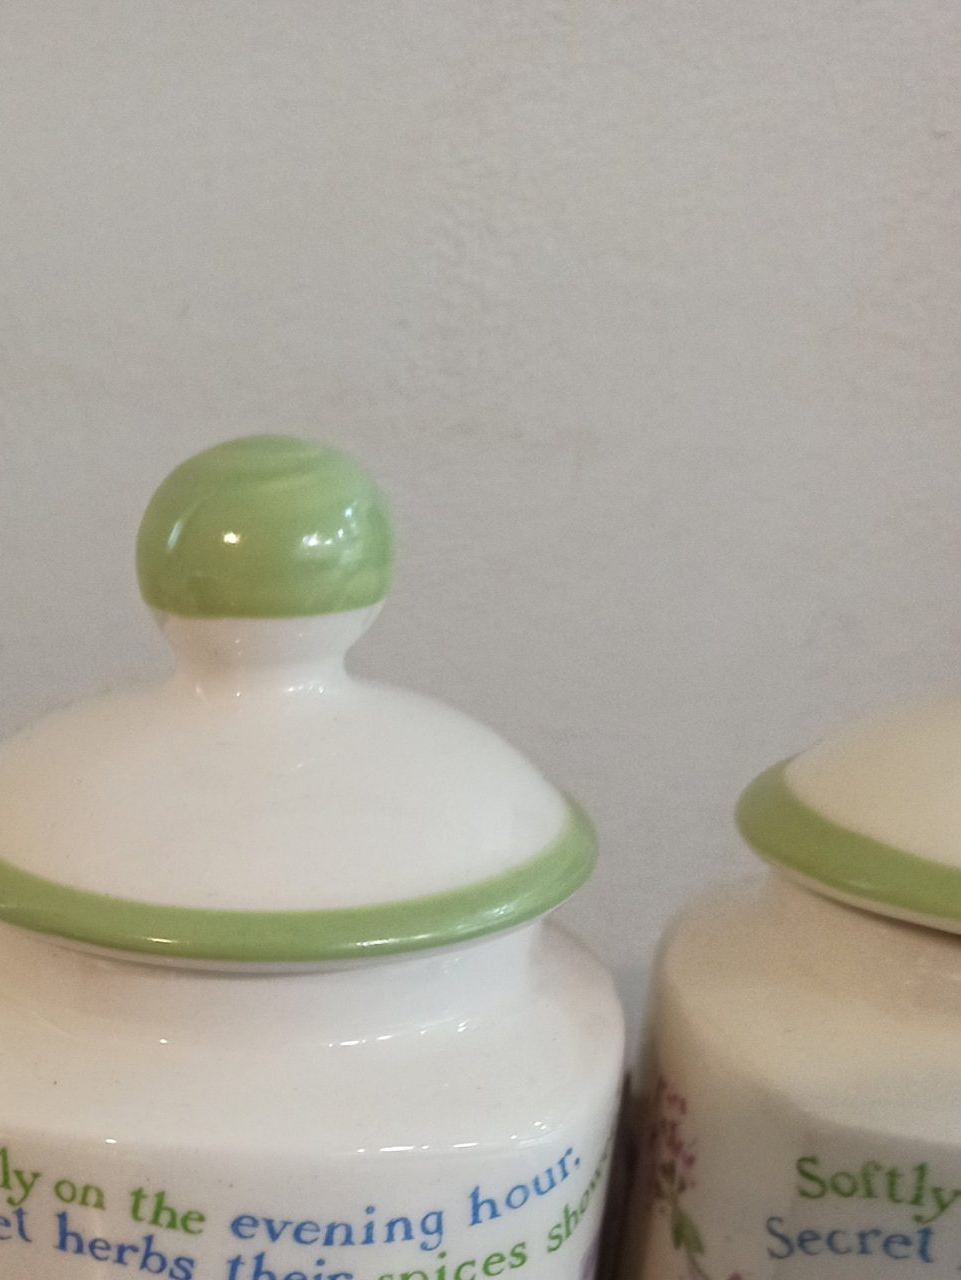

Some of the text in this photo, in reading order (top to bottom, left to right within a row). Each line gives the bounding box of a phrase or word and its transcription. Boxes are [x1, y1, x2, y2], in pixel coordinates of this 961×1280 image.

[54, 1178, 106, 1211] on
[130, 1186, 206, 1235] the
[229, 1205, 445, 1251] evening
[795, 1154, 961, 1225] Softly
[765, 1215, 935, 1264] Secret
